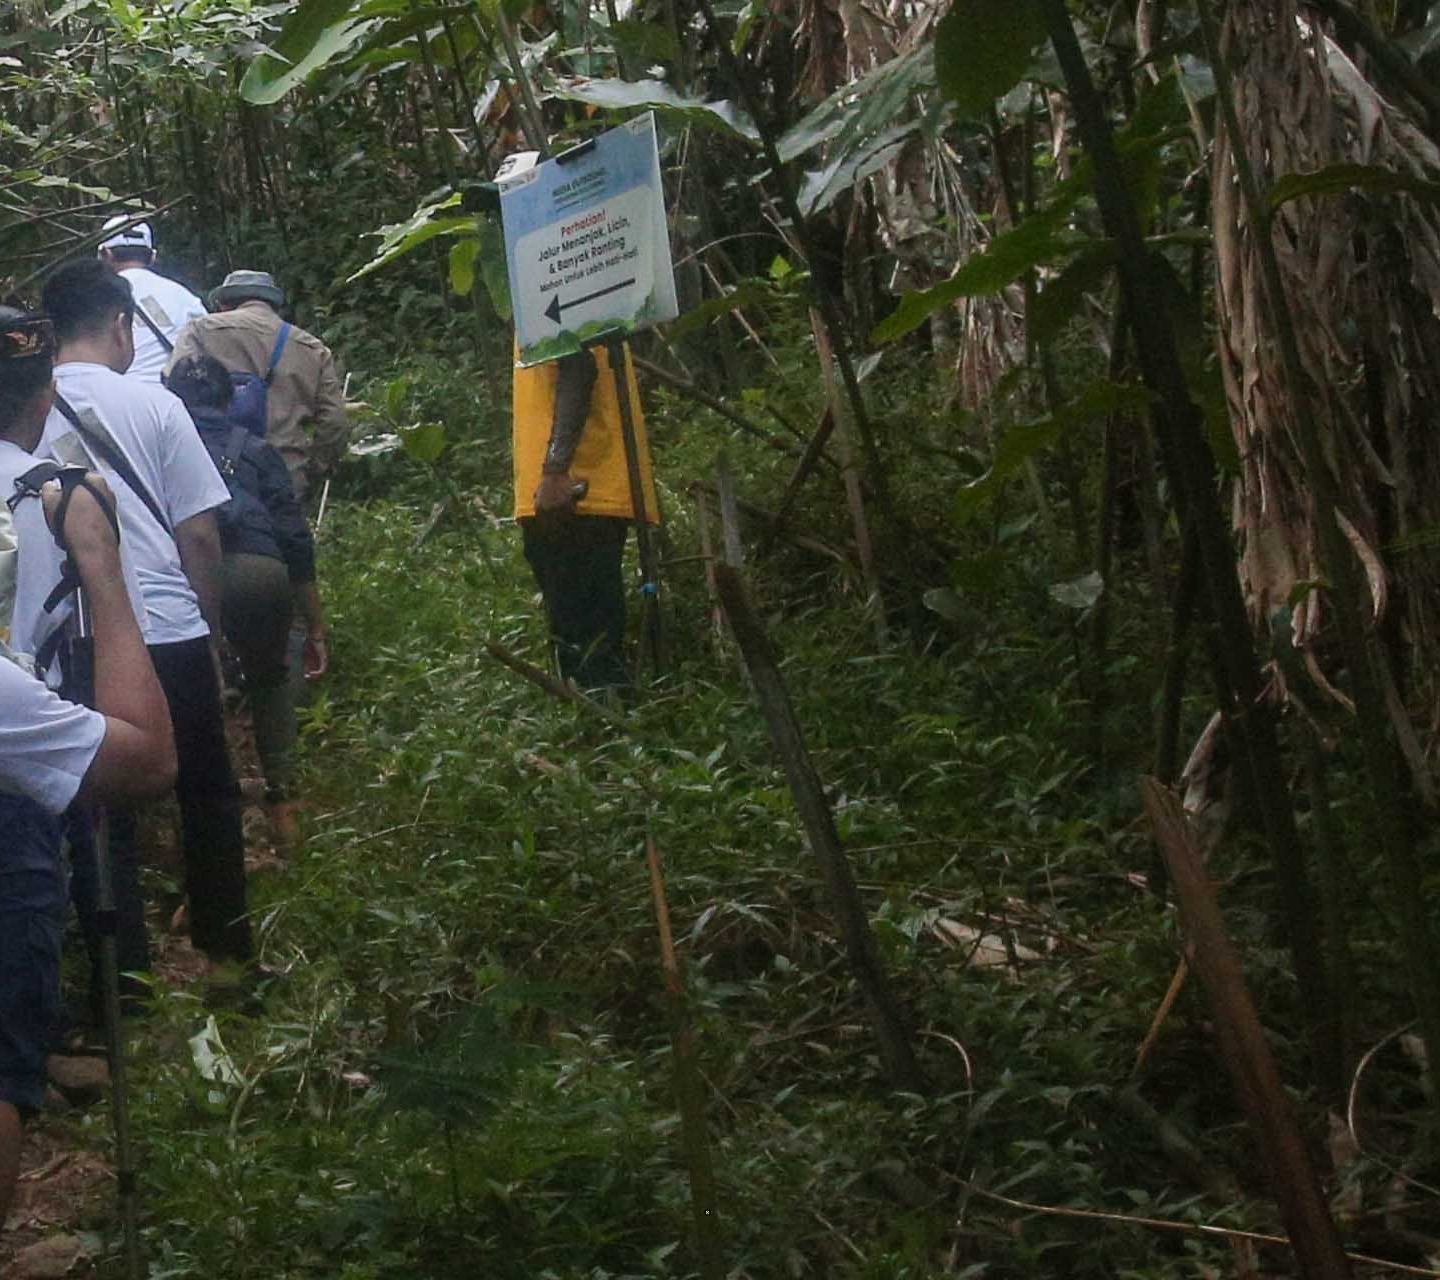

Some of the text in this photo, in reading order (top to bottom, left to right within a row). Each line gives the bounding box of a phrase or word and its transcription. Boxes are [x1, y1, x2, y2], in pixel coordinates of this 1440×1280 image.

[538, 246, 560, 262] Jalur
[549, 236, 626, 274] & Banyak Ranting
